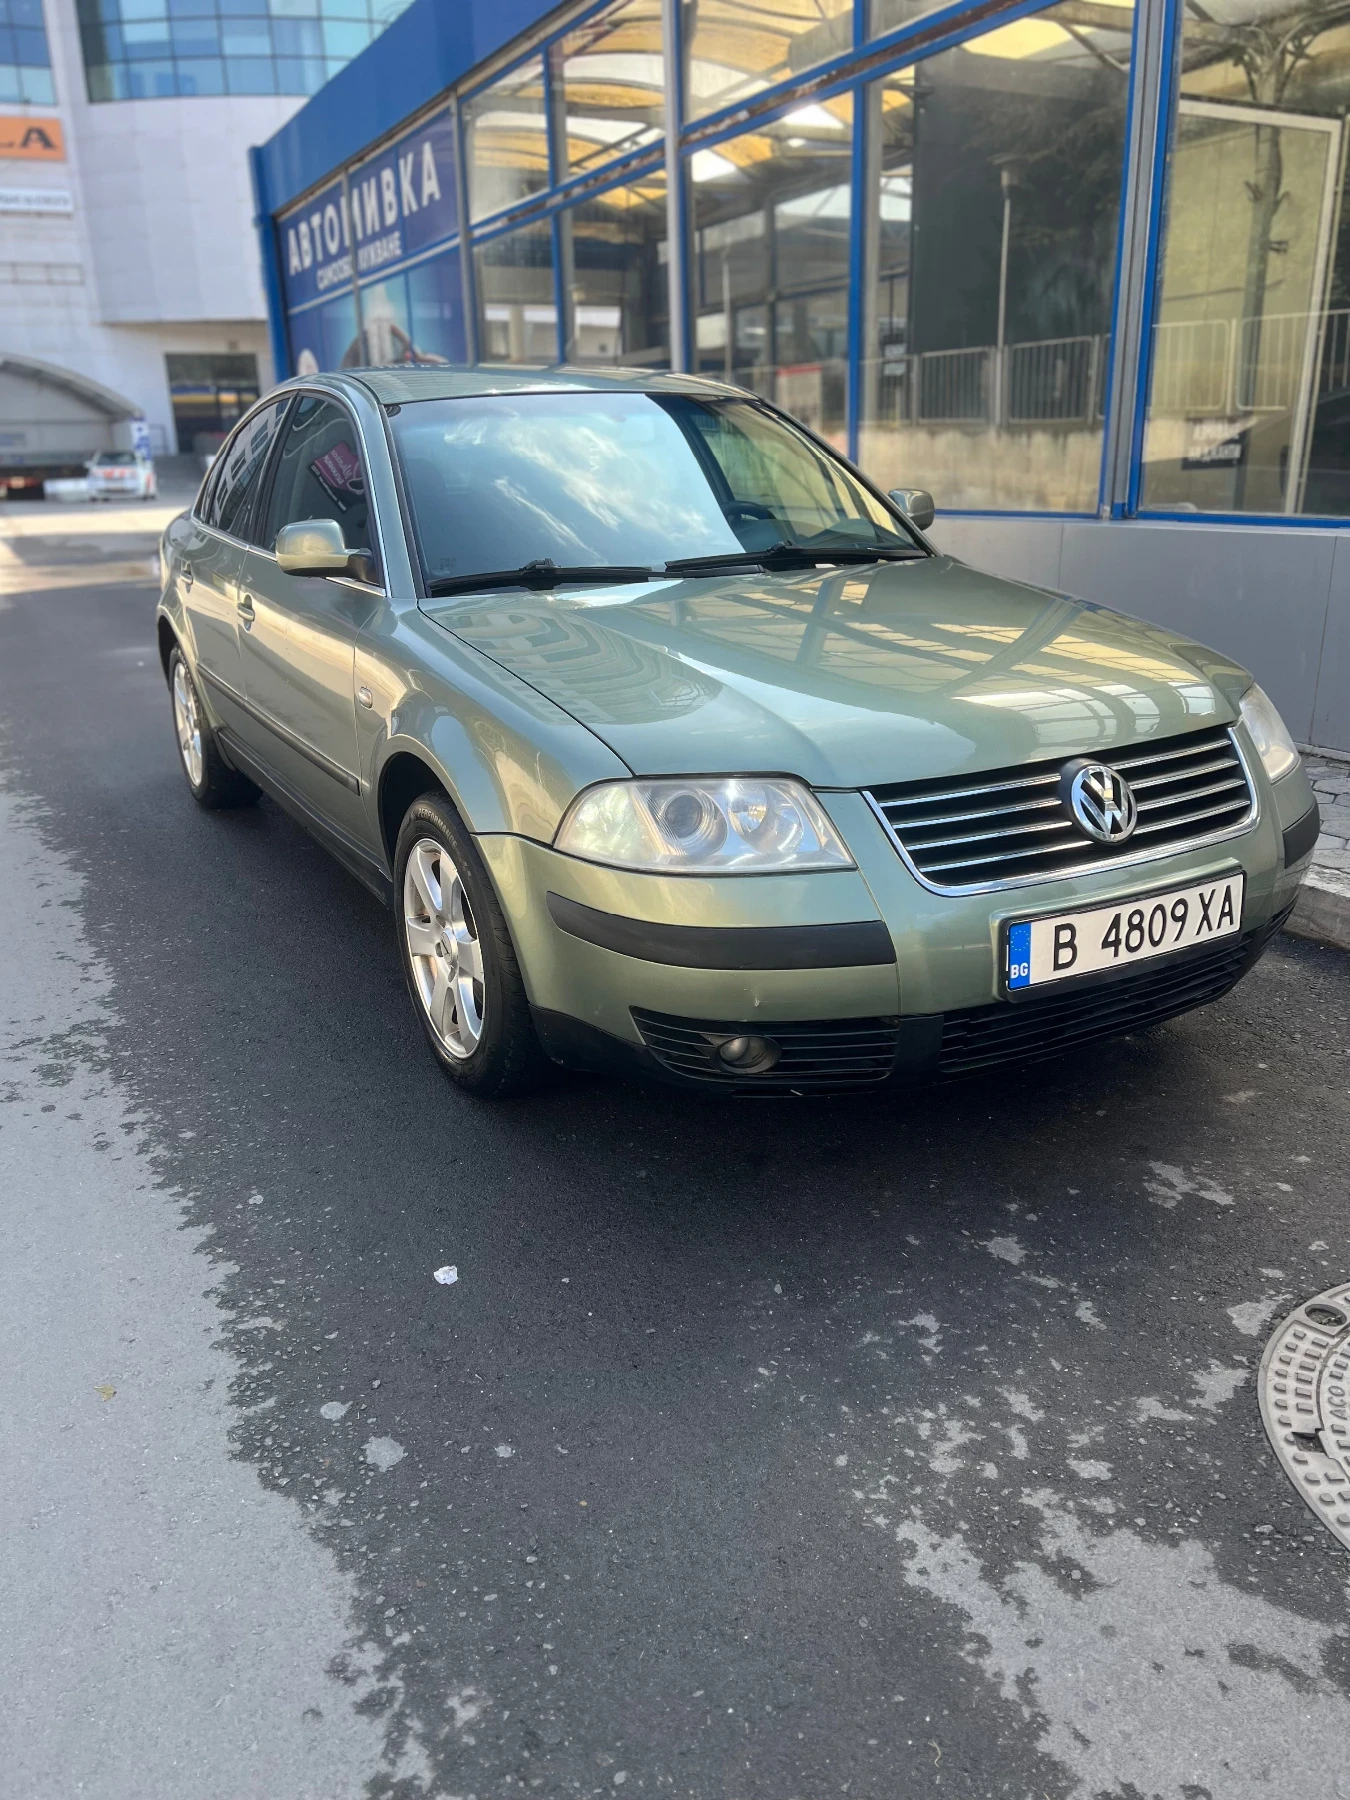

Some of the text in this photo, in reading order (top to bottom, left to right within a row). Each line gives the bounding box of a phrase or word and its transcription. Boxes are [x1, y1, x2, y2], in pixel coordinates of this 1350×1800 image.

[1010, 884, 1235, 979] BG B 4809 XA
